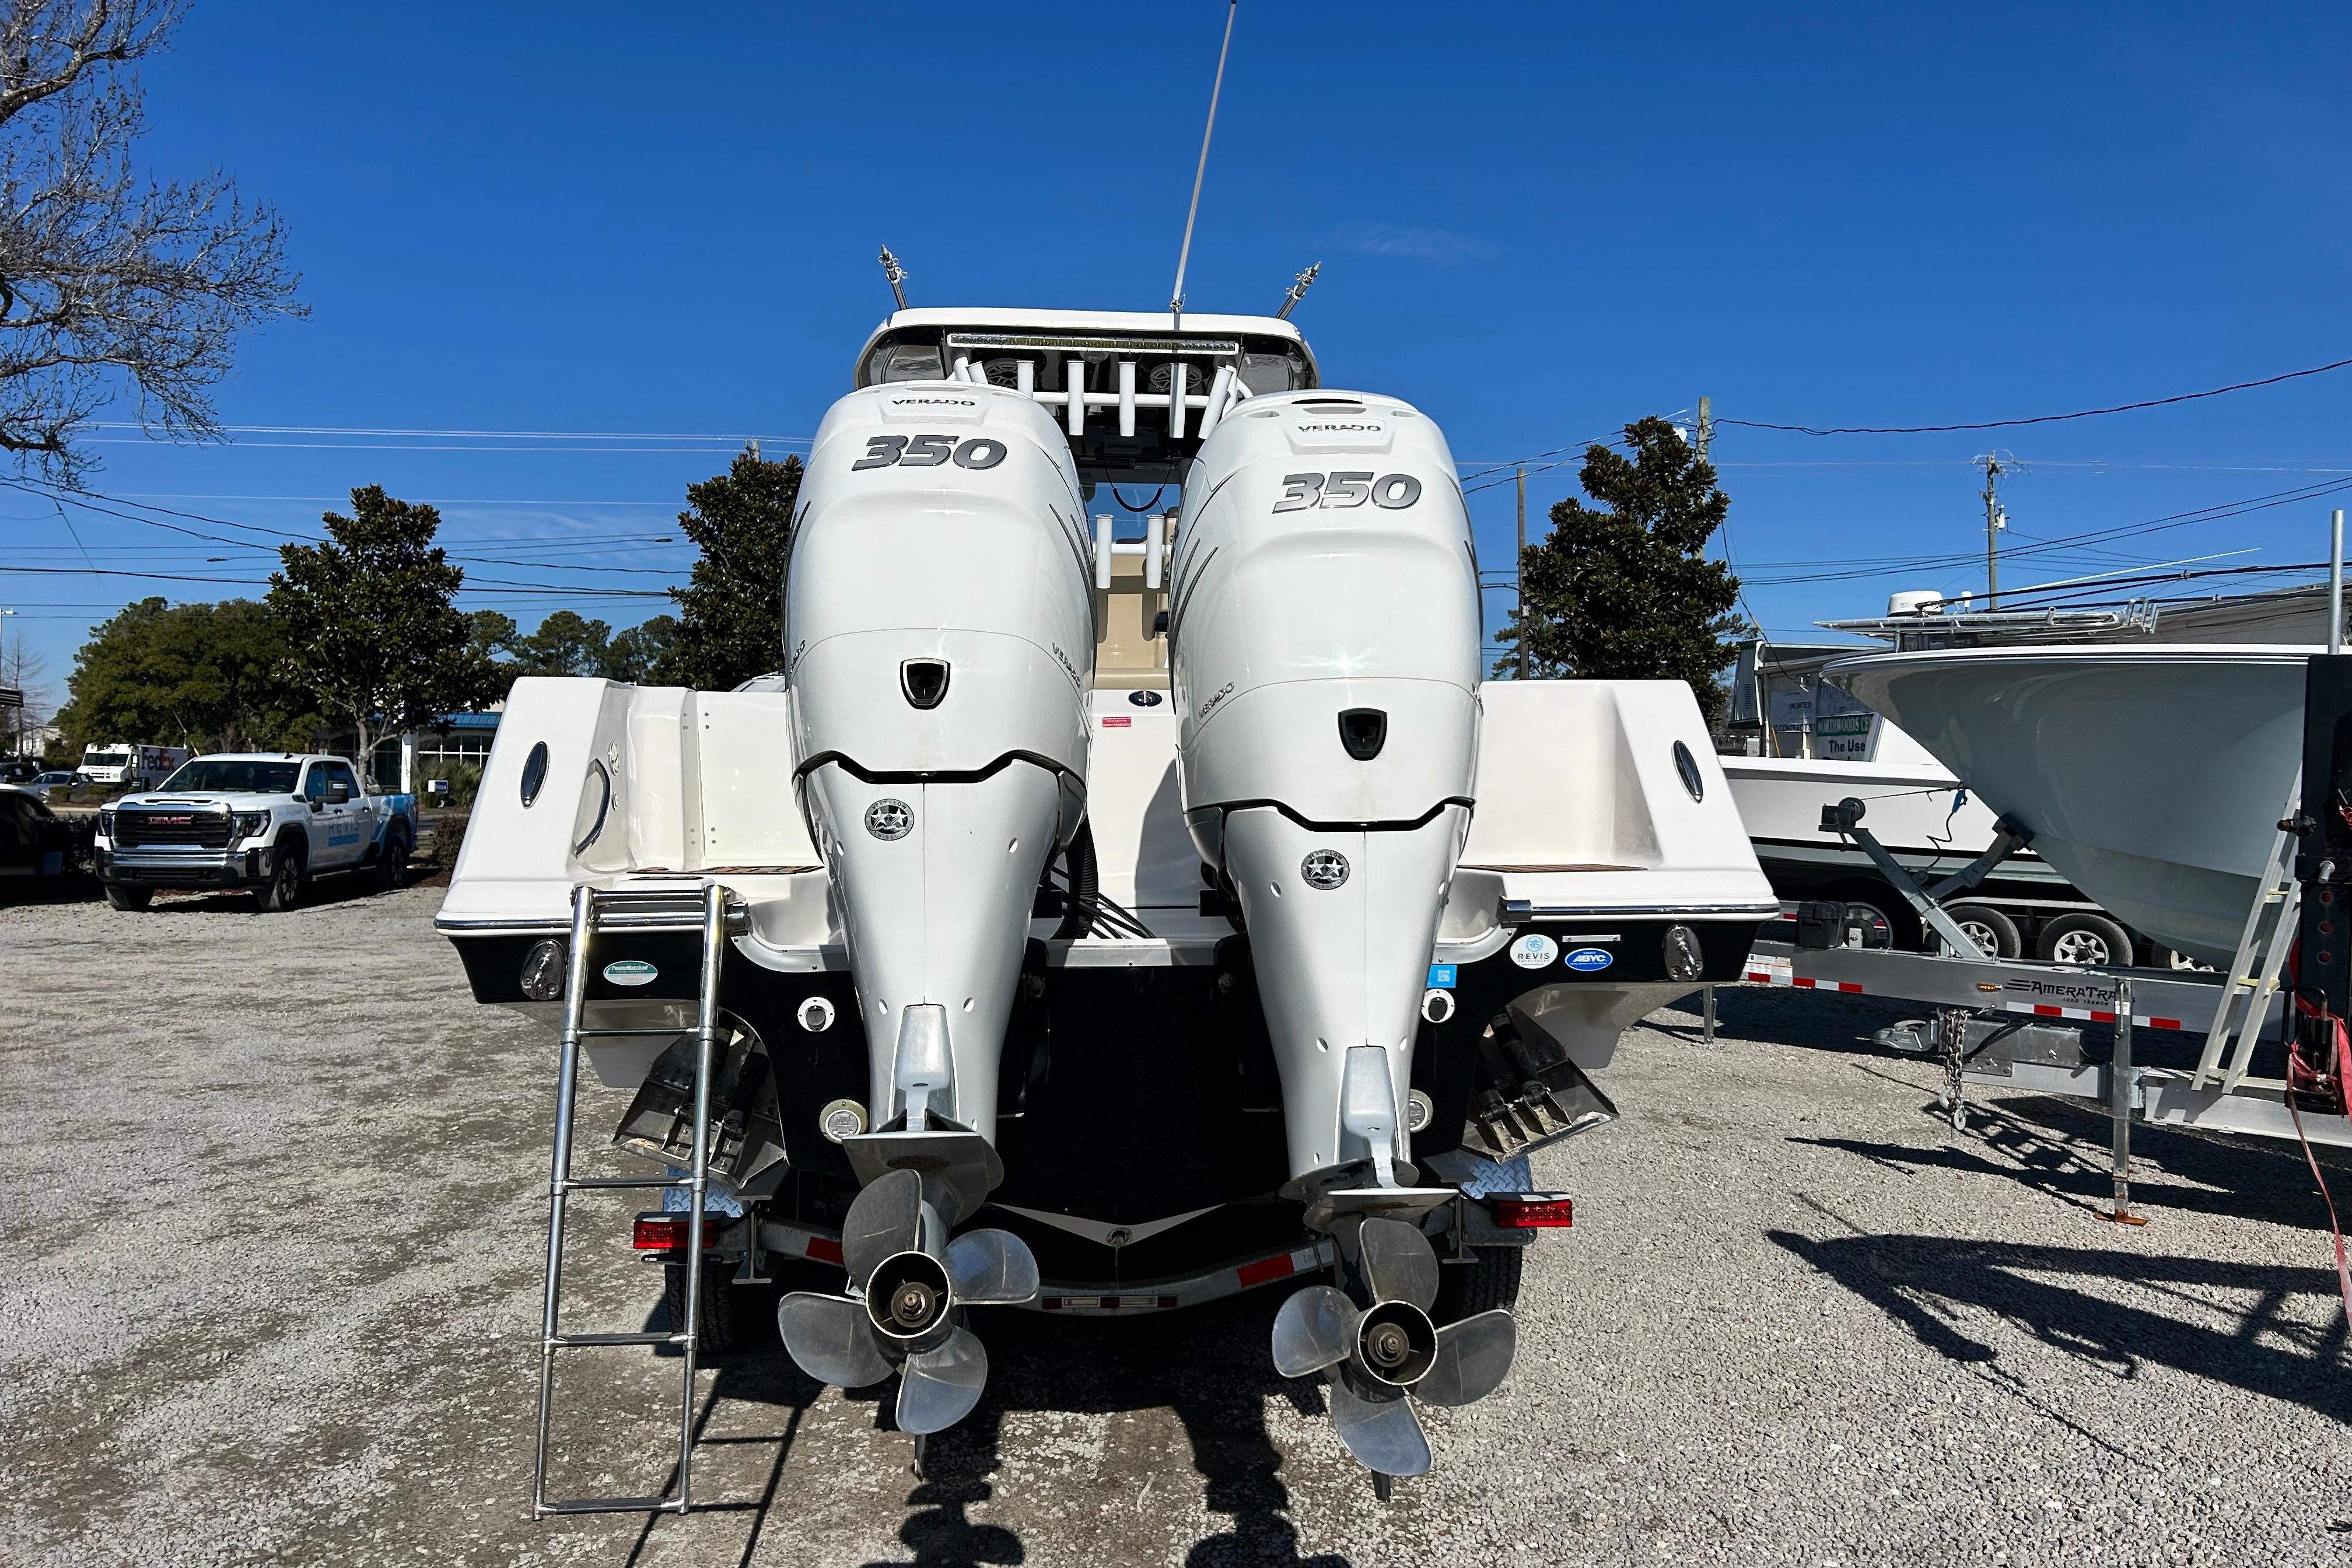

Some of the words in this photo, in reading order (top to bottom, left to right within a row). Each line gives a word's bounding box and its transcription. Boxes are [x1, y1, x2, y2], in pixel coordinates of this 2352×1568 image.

[892, 398, 975, 407] VERADO
[851, 434, 1007, 471] 350
[1272, 471, 1422, 514] 350
[1052, 642, 1081, 688] VERADO
[1829, 740, 1845, 753] The
[1847, 738, 1867, 752] Use
[142, 747, 176, 771] FedEx
[894, 800, 907, 810] LOW
[148, 816, 191, 825] GMC
[1573, 954, 1606, 963] ABYC
